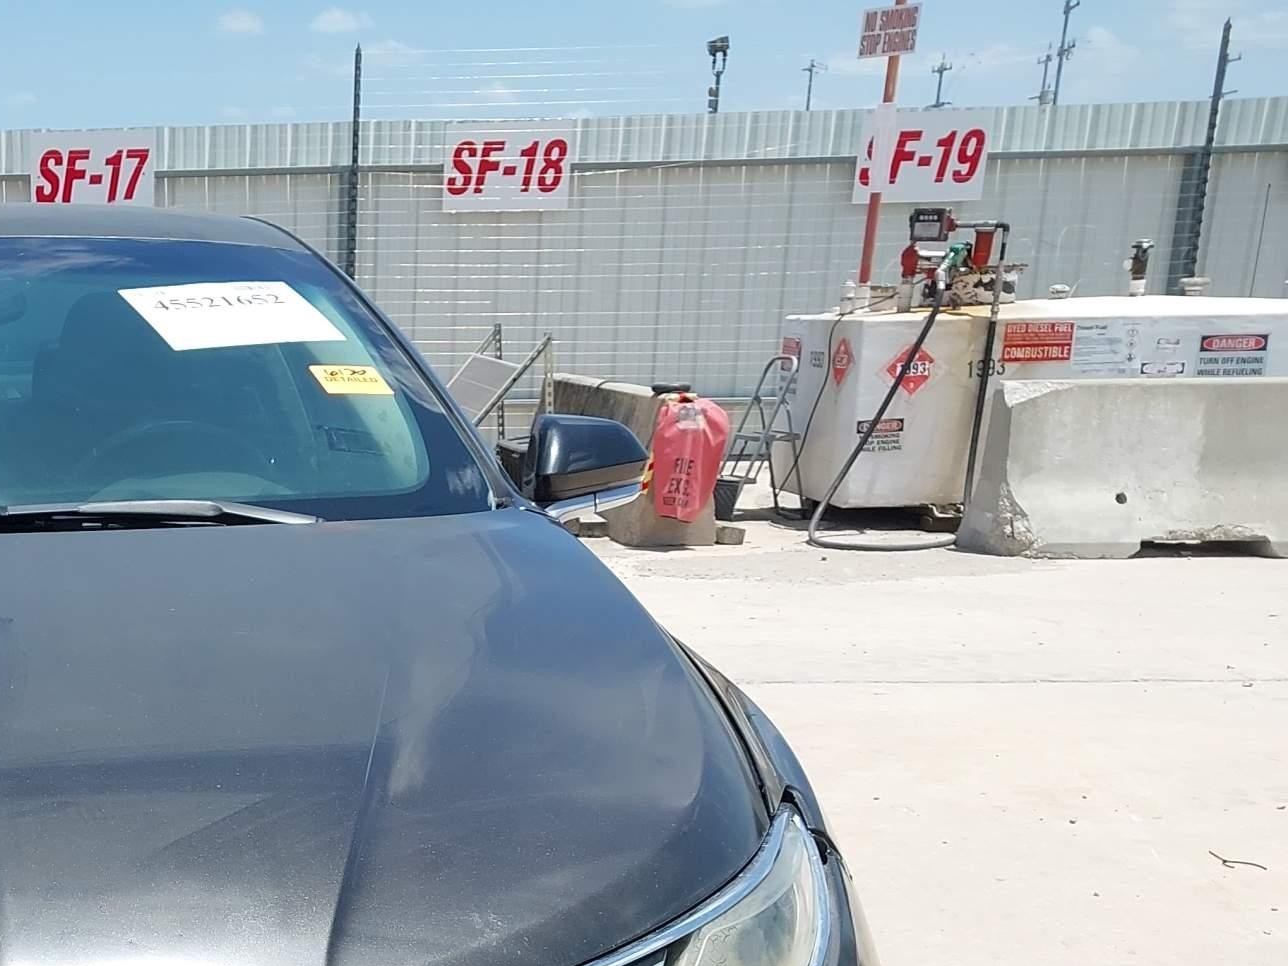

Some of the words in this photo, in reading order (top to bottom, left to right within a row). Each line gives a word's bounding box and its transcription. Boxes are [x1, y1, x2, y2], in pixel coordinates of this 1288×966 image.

[859, 33, 881, 56] STOP
[447, 139, 568, 195] SF-18
[35, 148, 150, 203] SF-17
[153, 293, 286, 311] 45521652
[1028, 323, 1052, 333] DIESEL
[1054, 323, 1072, 333] FUEL
[1212, 339, 1257, 349] DANGER
[1004, 345, 1070, 359] COMBUSTIBLE
[1199, 357, 1220, 365] TURN
[1221, 357, 1235, 365] OFF
[1236, 356, 1265, 364] ENGINE
[1222, 368, 1263, 376] REFUELING
